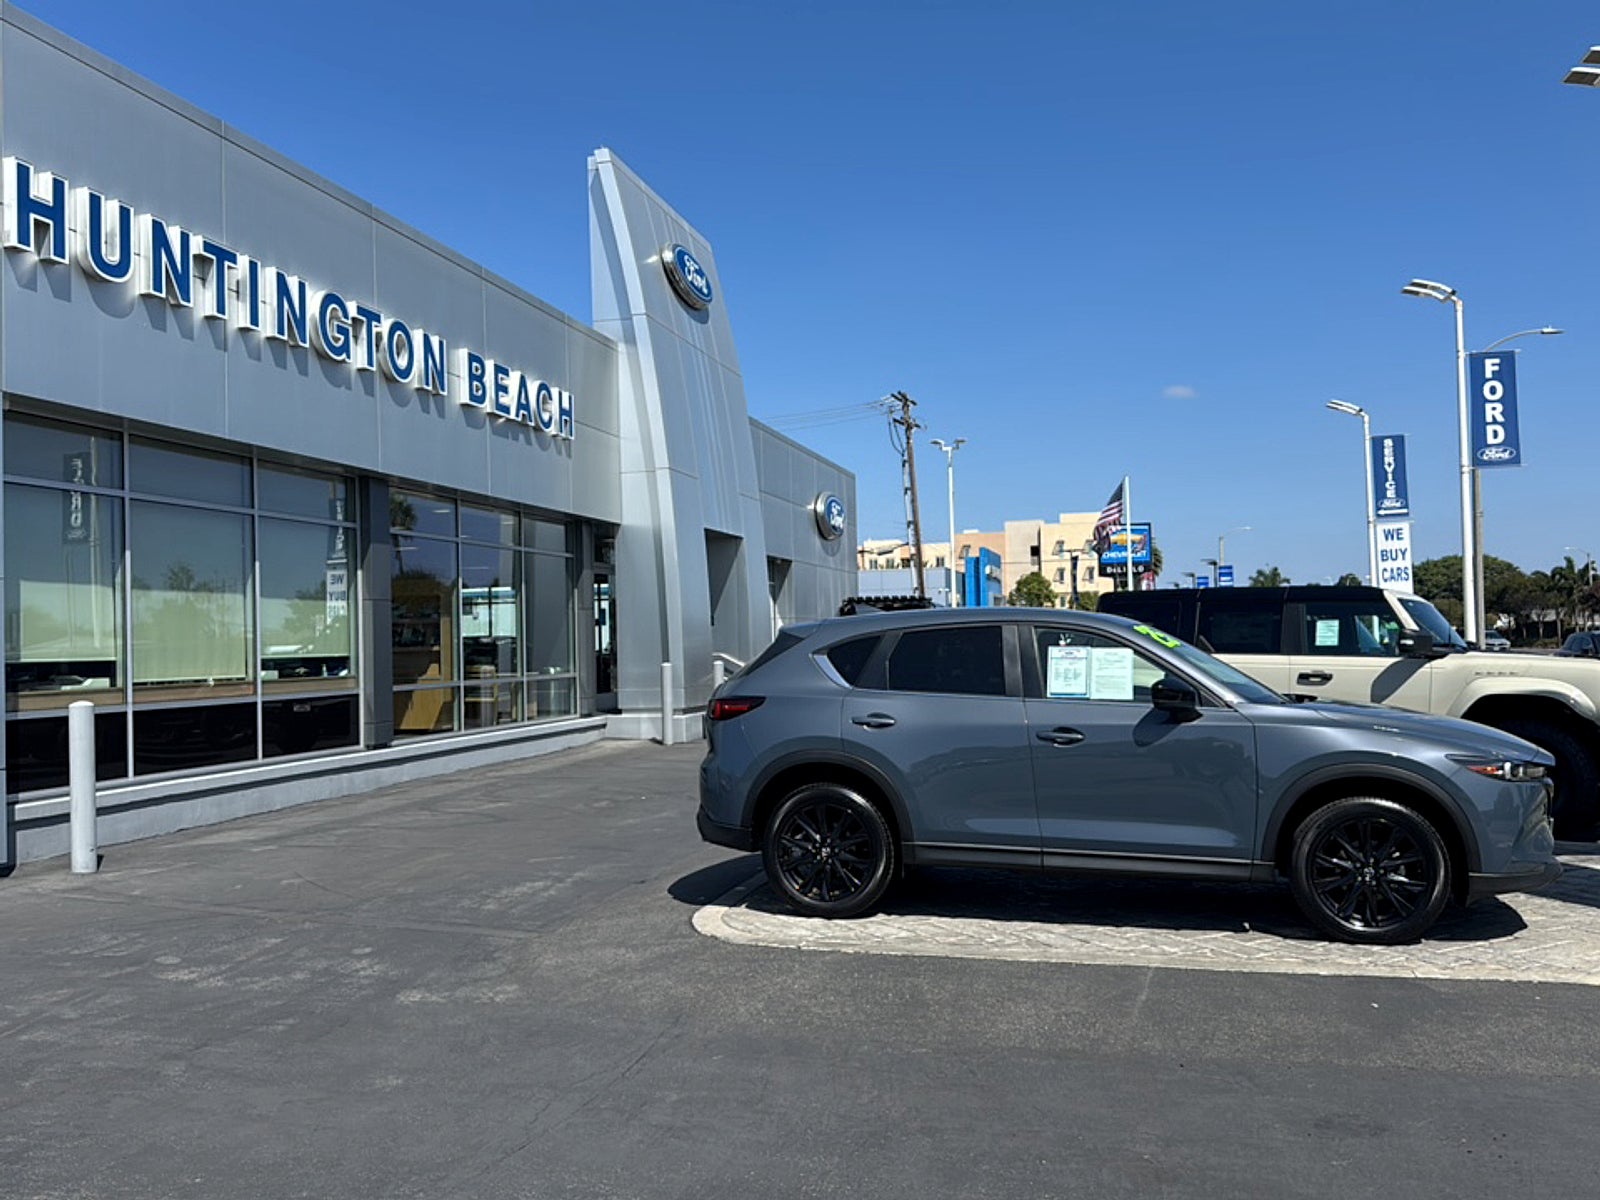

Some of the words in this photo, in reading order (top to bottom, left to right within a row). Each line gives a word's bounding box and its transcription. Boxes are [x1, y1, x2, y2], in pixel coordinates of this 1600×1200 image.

[684, 254, 709, 295] Ford
[3, 156, 448, 396] HUNTINGTON
[459, 347, 575, 440] BEACH
[1483, 358, 1505, 445] FORD
[1483, 446, 1511, 460] Ford
[1383, 438, 1397, 498] SERVICE
[1383, 528, 1404, 541] WE
[1380, 548, 1408, 562] BUY
[1381, 567, 1409, 583] CARS
